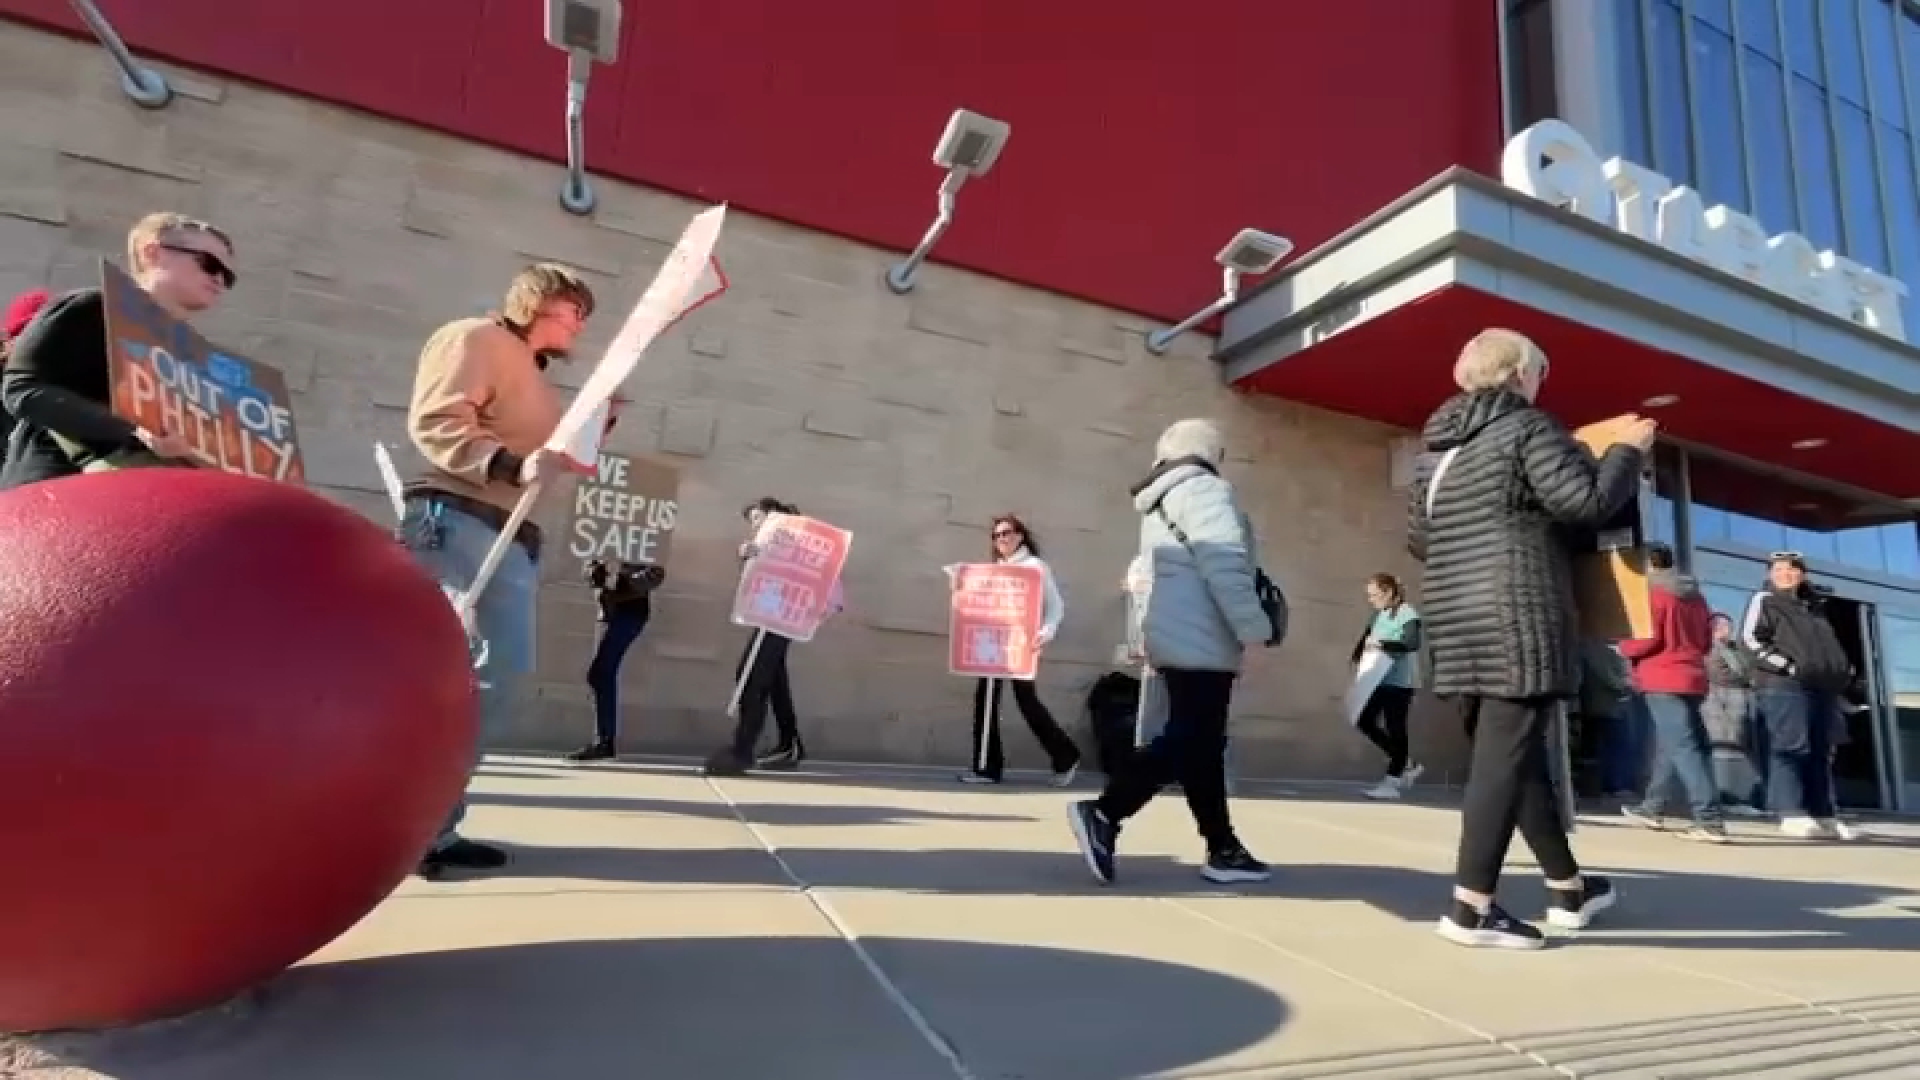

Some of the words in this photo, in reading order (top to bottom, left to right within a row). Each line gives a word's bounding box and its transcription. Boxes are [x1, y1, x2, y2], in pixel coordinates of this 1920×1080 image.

[128, 361, 294, 481] PHILLY
[151, 346, 224, 414] OUT
[237, 397, 291, 440] OF
[570, 518, 659, 563] SAFE
[575, 484, 646, 522] KEEP
[647, 497, 678, 530] US
